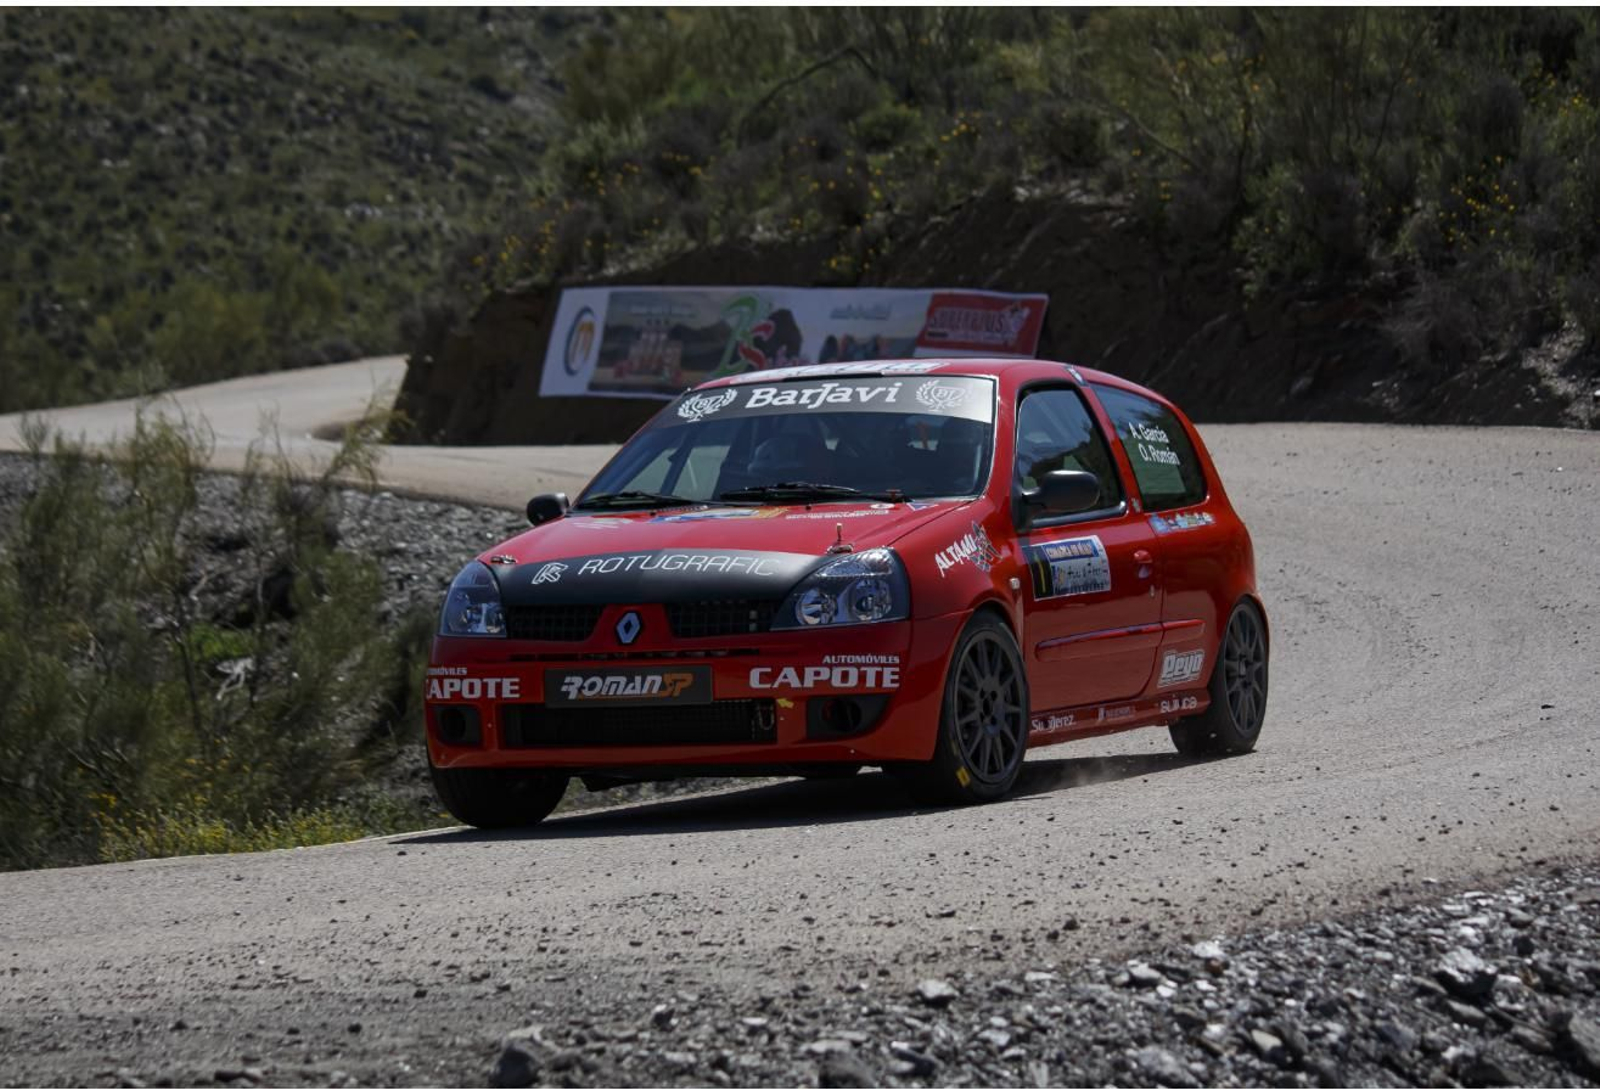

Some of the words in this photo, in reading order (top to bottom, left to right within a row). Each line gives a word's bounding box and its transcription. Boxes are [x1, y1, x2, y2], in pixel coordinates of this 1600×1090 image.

[578, 553, 782, 576] ROTUGRAFIC
[822, 653, 900, 664] AUTOMÓVILES
[426, 677, 520, 700] APOTE
[748, 665, 900, 689] CAPOTE
